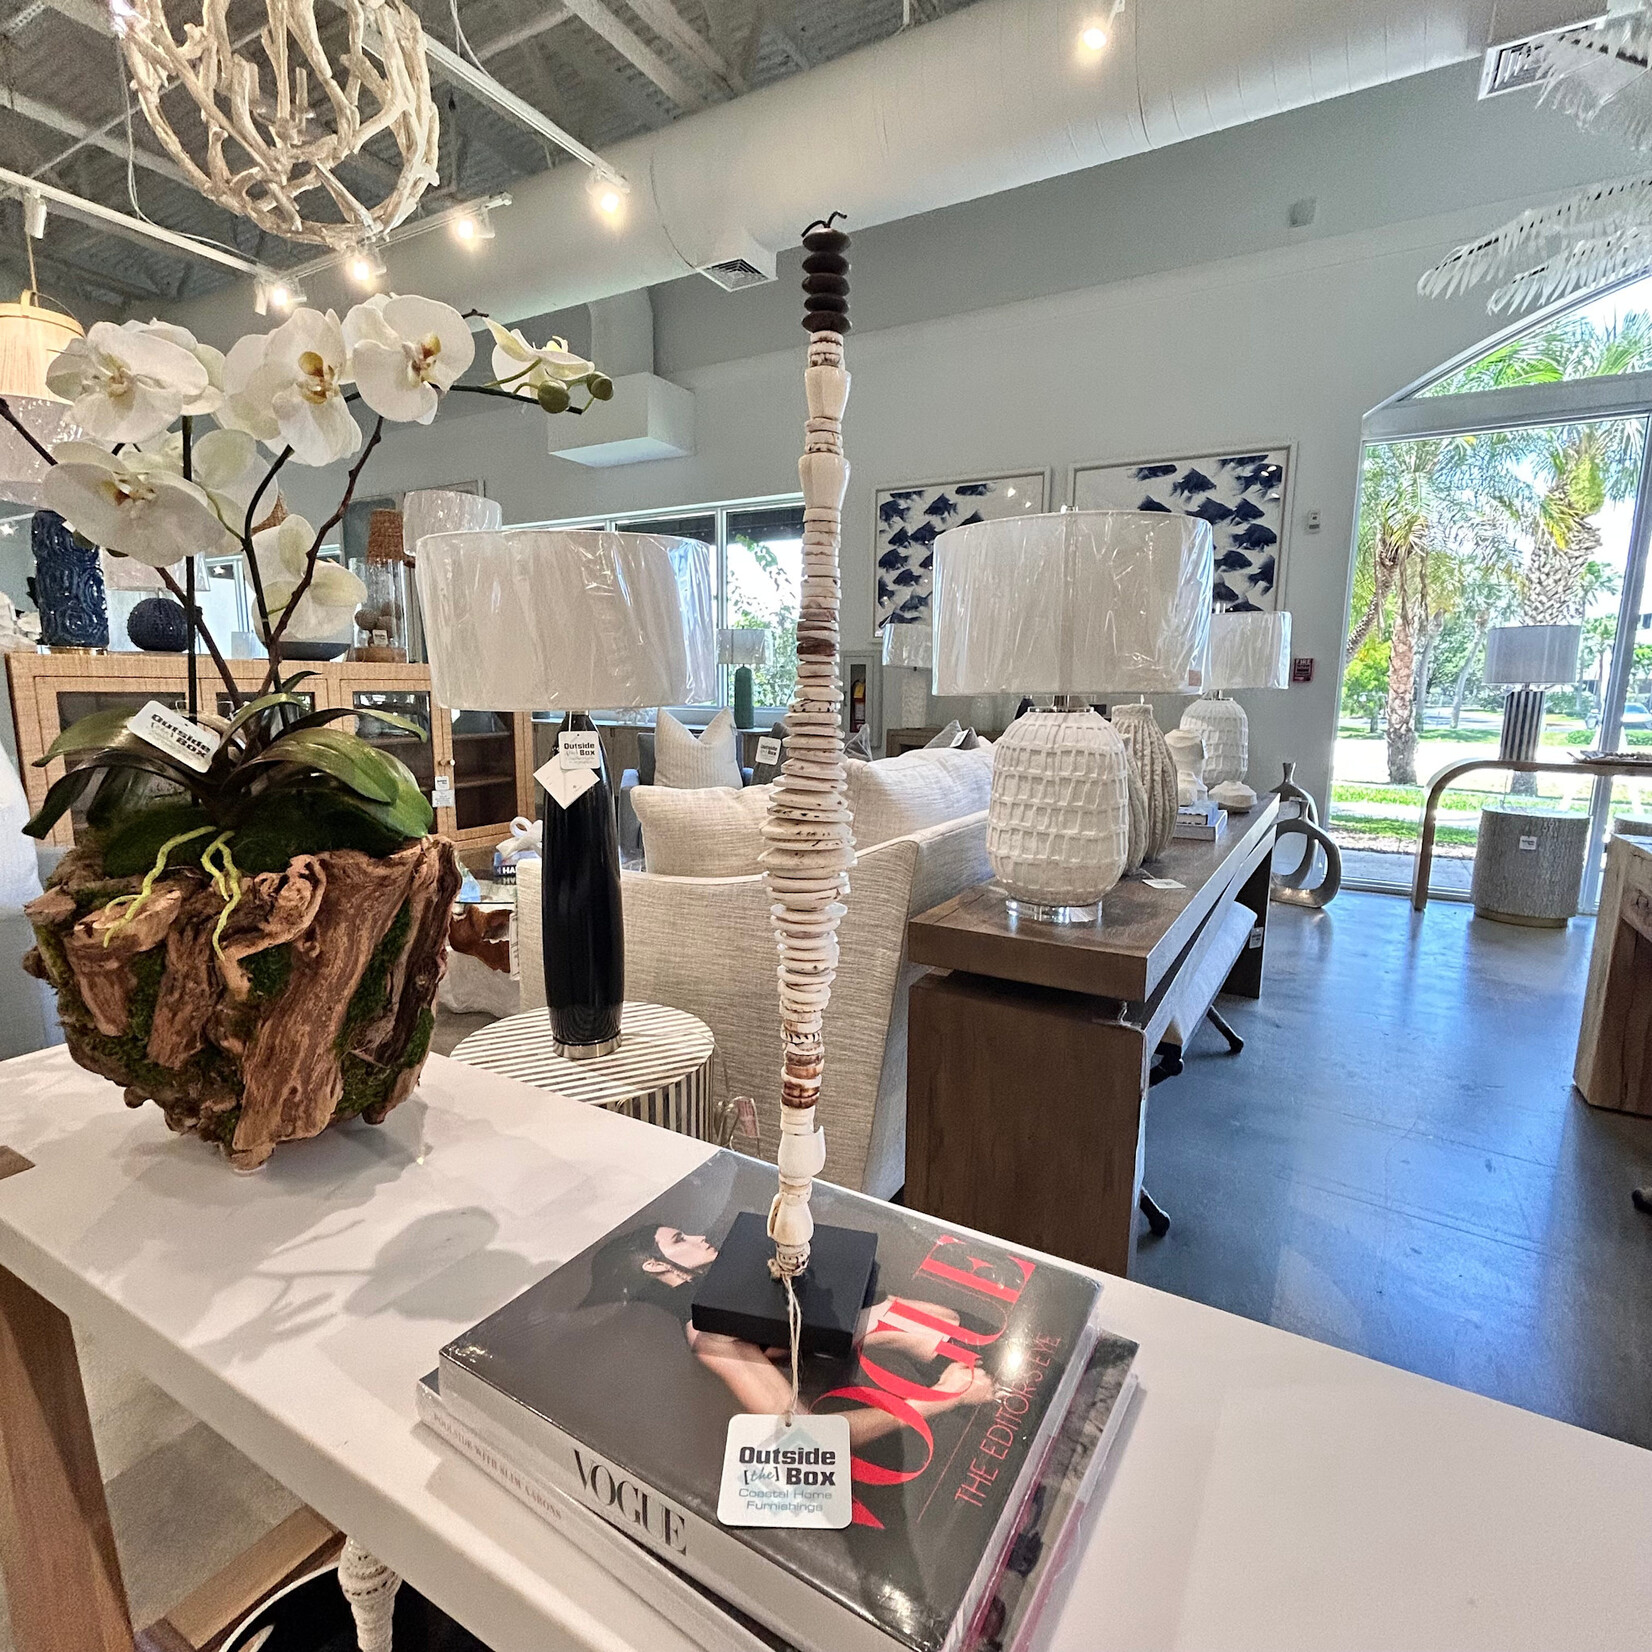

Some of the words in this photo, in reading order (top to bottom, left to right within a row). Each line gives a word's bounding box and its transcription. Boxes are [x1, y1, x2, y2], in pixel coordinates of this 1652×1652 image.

[151, 713, 211, 753] Outside
[176, 737, 207, 758] Box
[563, 742, 595, 750] Outside
[502, 866, 518, 874] HA
[808, 1234, 1036, 1530] OGUE
[955, 1458, 999, 1508] THE
[979, 1366, 1044, 1461] EDITORS
[1026, 1332, 1062, 1368] EYE
[739, 1446, 836, 1465] Outside
[786, 1467, 836, 1486] Box
[574, 1449, 687, 1556] VOGUE
[739, 1488, 789, 1499] Coastal
[793, 1489, 832, 1499] Home
[746, 1500, 824, 1513] Furnishings
